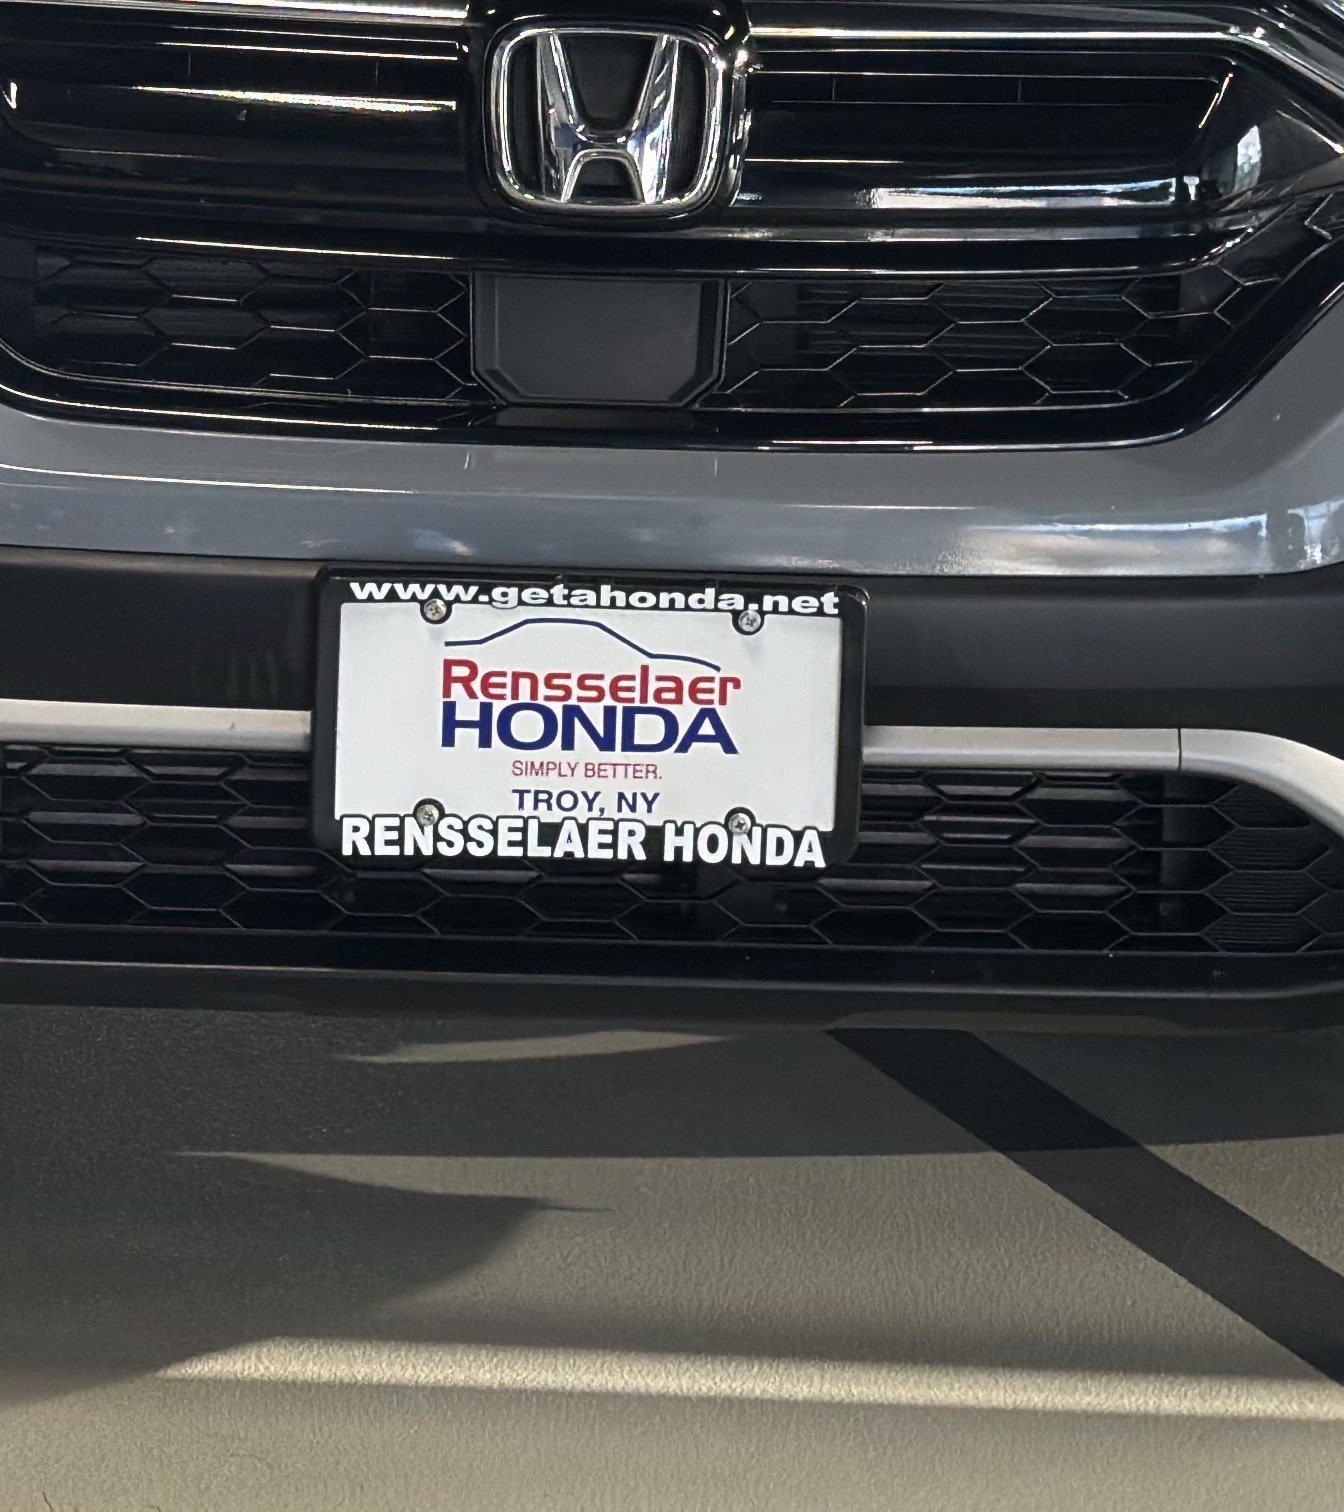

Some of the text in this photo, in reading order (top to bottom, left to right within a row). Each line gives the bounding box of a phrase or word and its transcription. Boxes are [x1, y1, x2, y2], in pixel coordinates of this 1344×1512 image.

[349, 581, 839, 615] www.getahonda.net
[442, 658, 741, 706] Rensselaer
[441, 702, 739, 754] HONDA
[511, 760, 662, 781] SIMPLY BETTER.
[512, 789, 660, 816] TROY, NY
[342, 816, 826, 868] RENSSELAER HONDA
